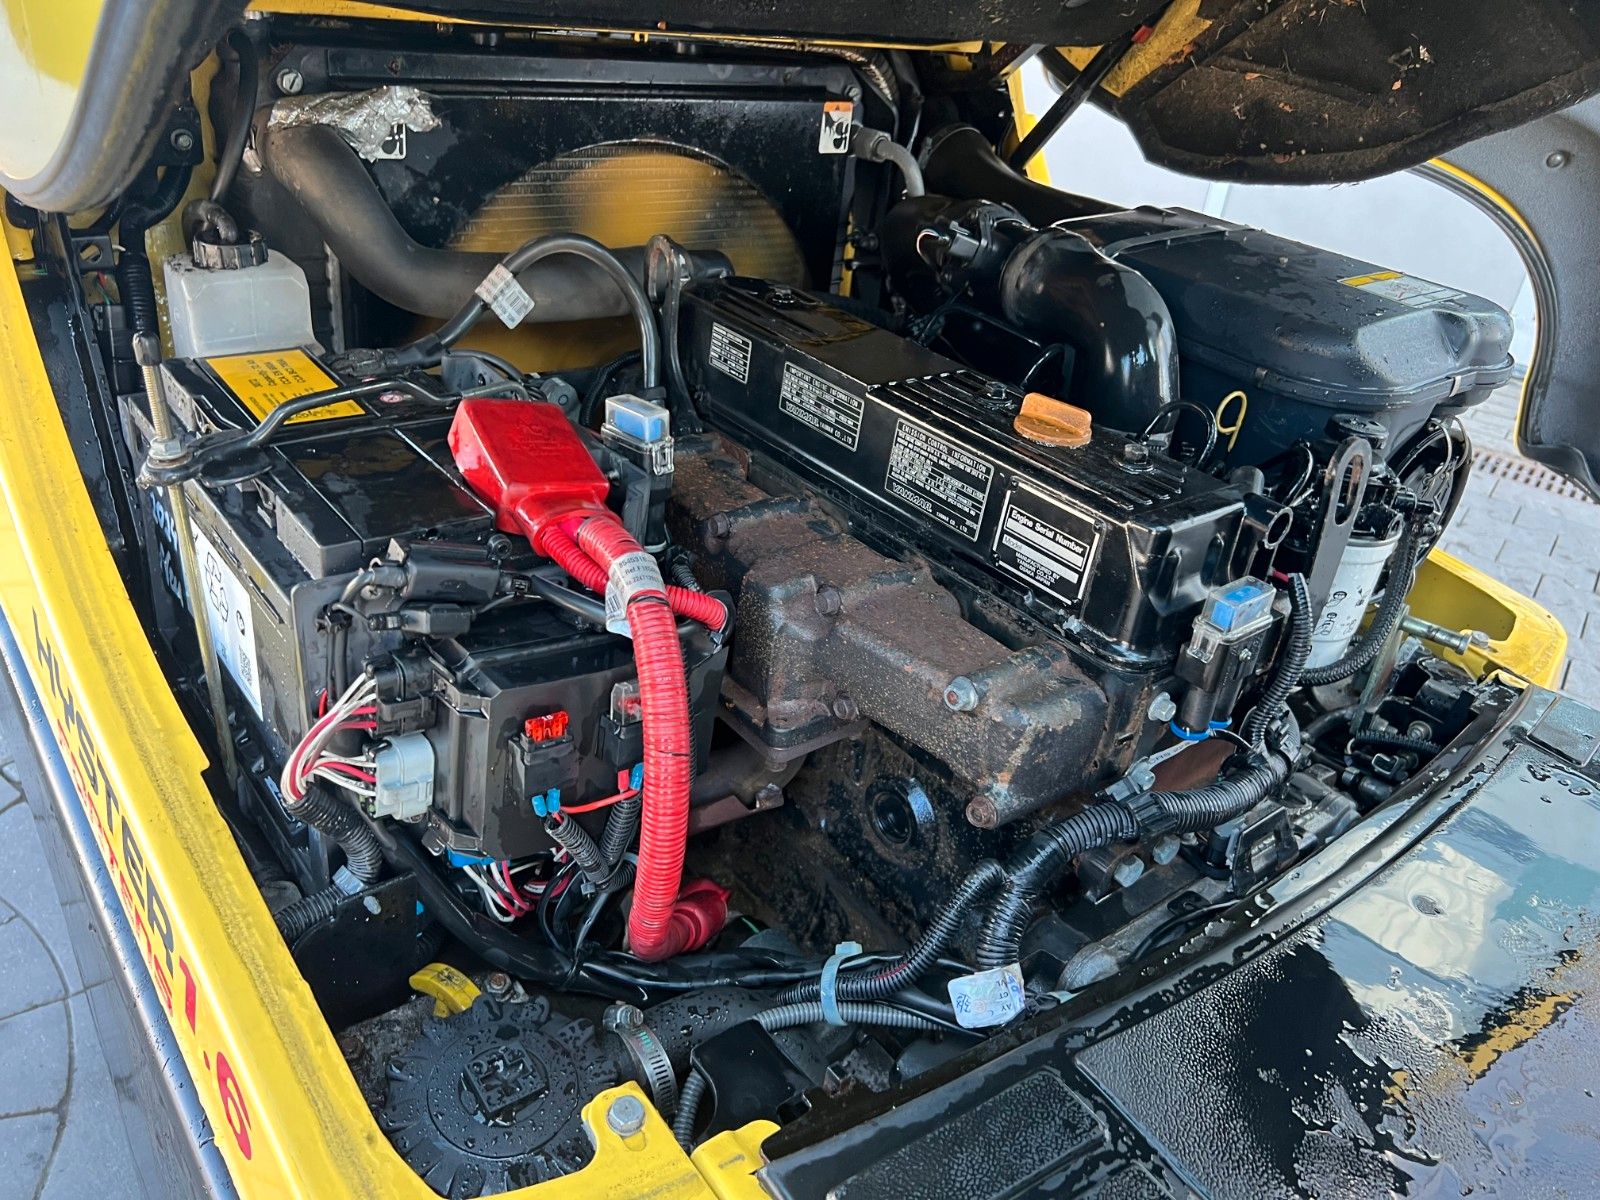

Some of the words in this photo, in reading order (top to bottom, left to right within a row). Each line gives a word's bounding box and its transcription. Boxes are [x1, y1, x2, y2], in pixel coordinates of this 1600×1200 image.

[829, 387, 858, 407] INFORMATION
[902, 424, 925, 441] EMISSION
[927, 437, 948, 453] CONTROL
[951, 450, 986, 473] INFORMATION
[1011, 509, 1033, 529] Engine
[1034, 521, 1054, 539] Serial
[1055, 533, 1083, 555] Number
[32, 606, 175, 980] HYSTER
[179, 955, 252, 1161] 1.6
